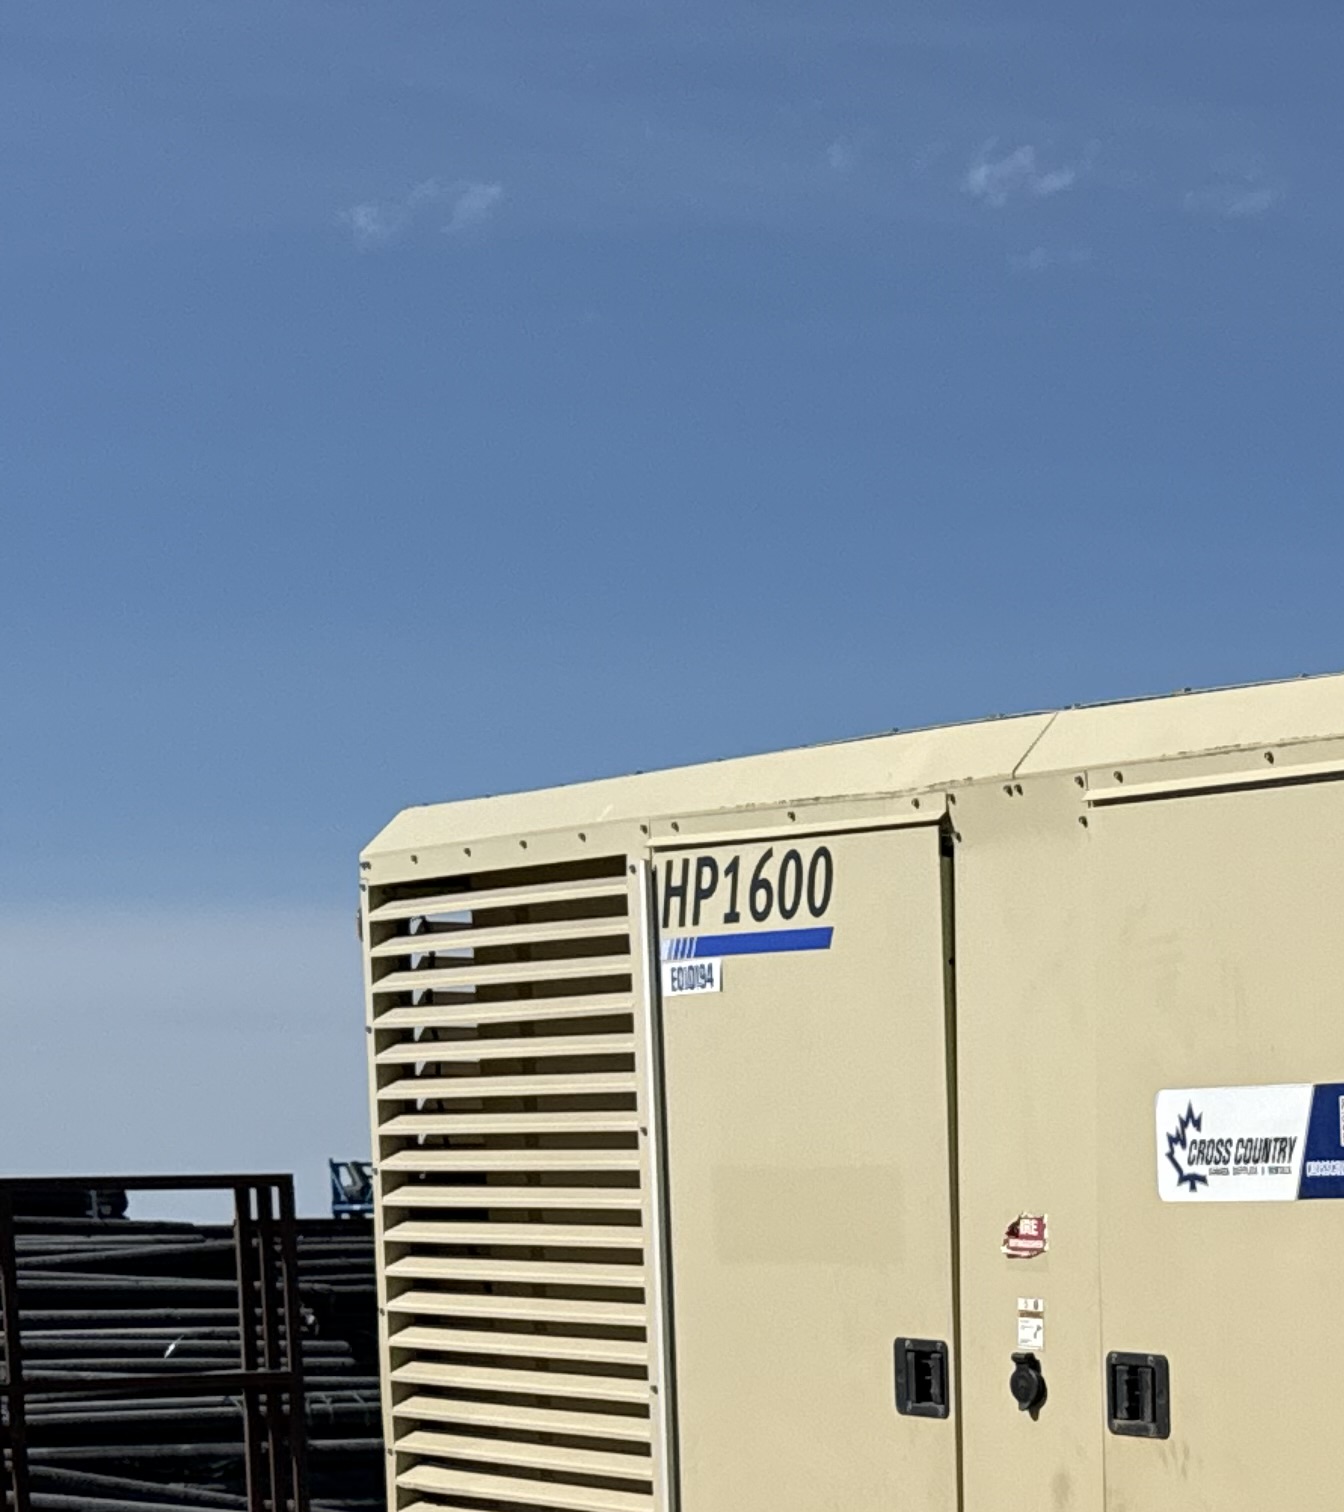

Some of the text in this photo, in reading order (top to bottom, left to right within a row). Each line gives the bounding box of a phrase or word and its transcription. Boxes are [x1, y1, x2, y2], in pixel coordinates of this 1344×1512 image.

[662, 845, 834, 929] HP1600
[1187, 1136, 1297, 1166] CROSS COUNTRY
